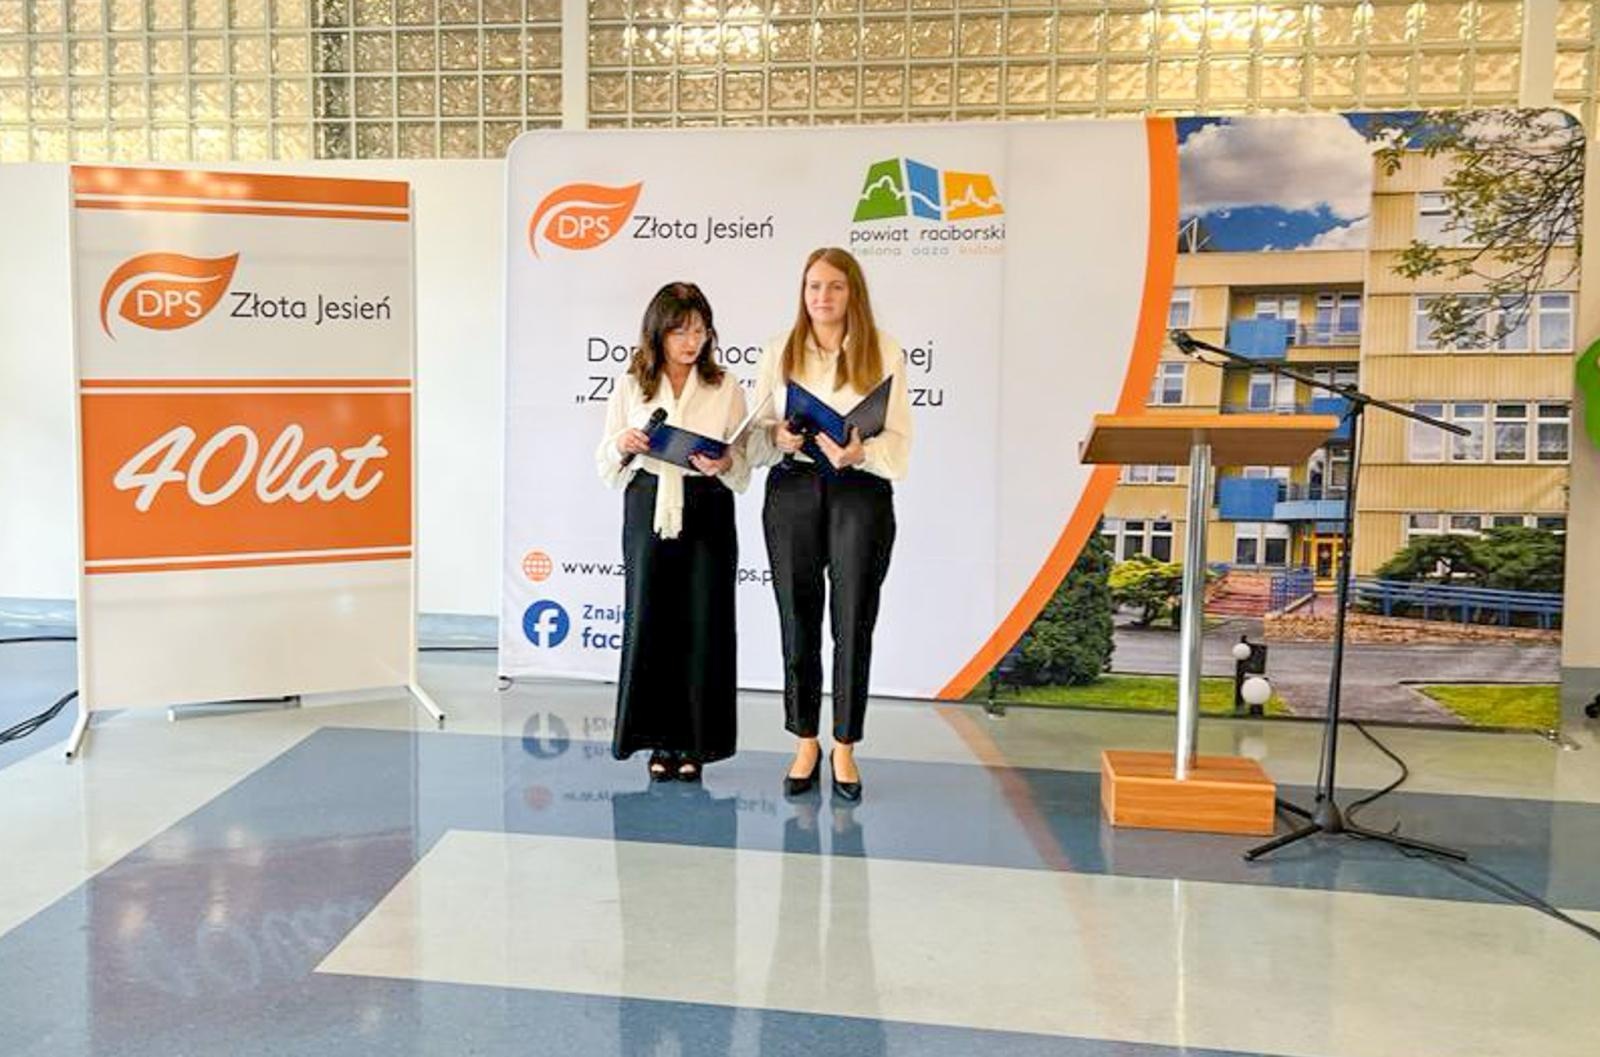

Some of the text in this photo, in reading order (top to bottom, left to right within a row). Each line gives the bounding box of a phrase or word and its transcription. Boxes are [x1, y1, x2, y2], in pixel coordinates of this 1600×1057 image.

[557, 215, 610, 240] DPS
[633, 215, 774, 245] Złota Jesień
[849, 223, 1006, 245] powiat raciborski
[136, 289, 203, 318] DPS
[230, 291, 391, 326] Złota Jesień
[582, 604, 621, 624] Znaj
